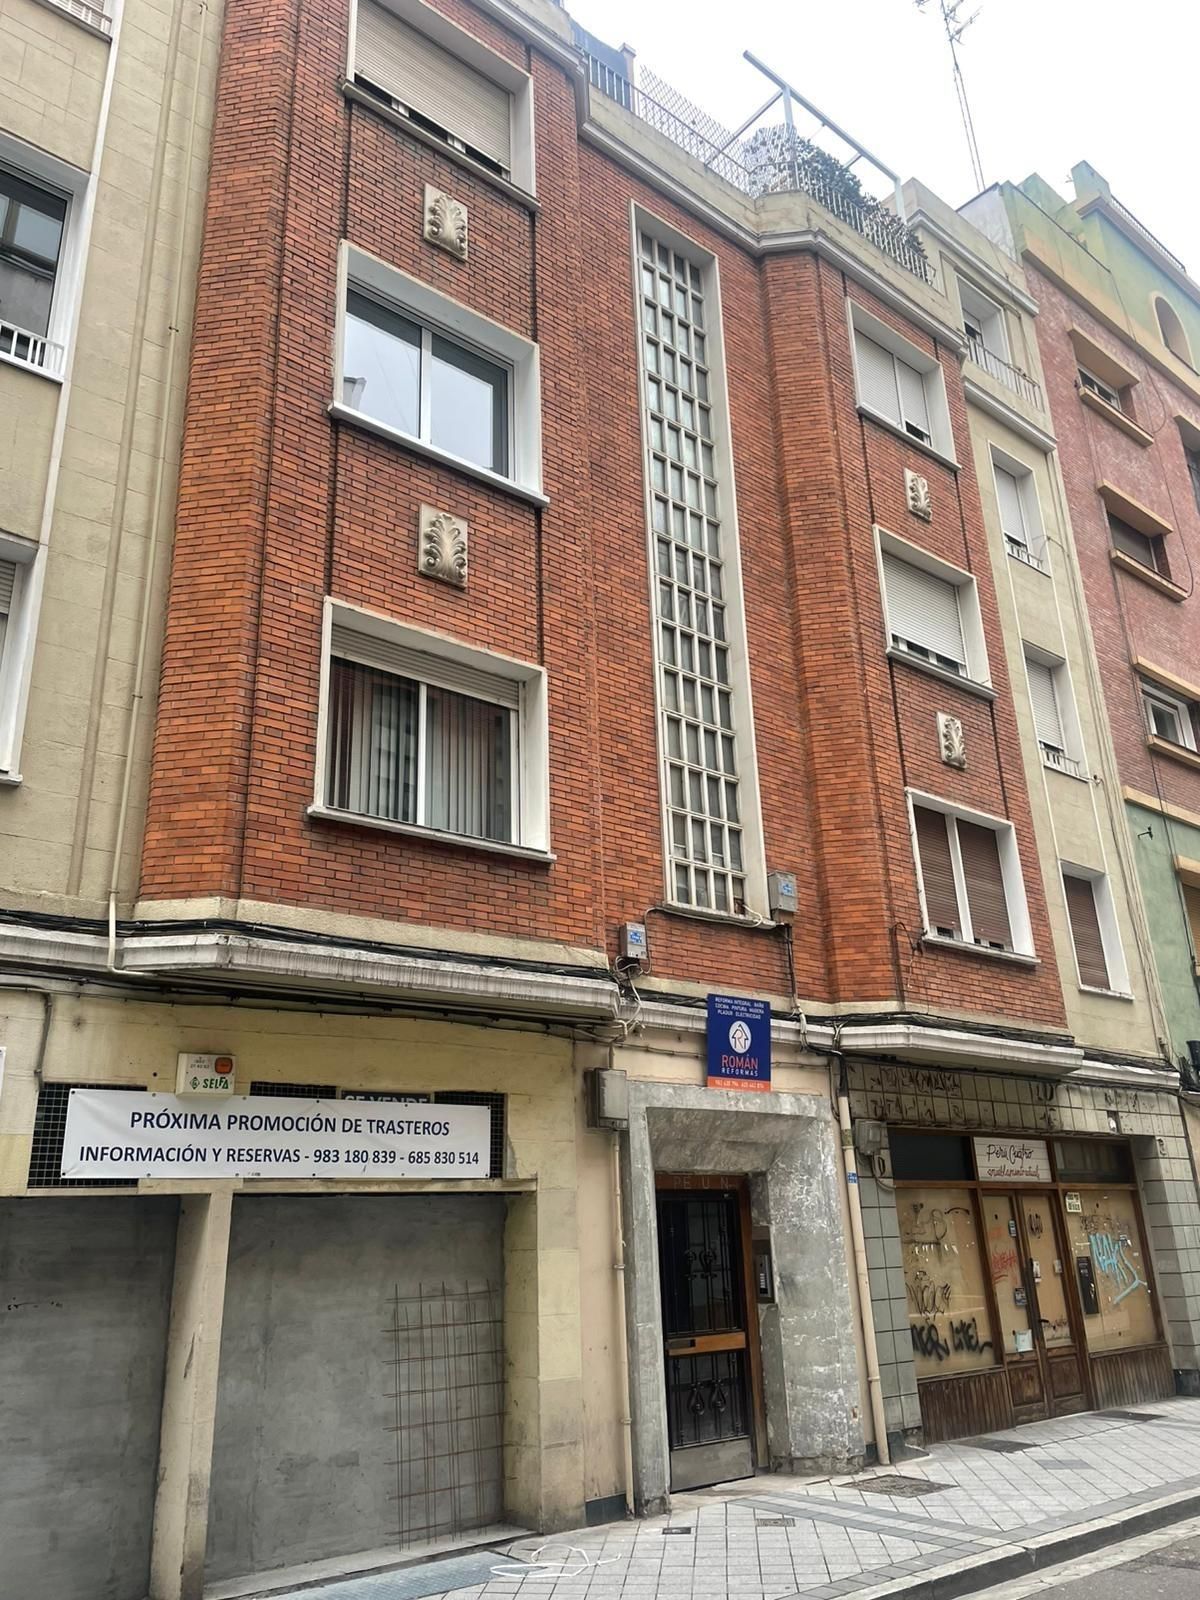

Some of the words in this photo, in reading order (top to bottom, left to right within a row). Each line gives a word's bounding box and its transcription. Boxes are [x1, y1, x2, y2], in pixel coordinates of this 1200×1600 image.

[721, 1054, 759, 1070] ROMÁN
[721, 1067, 759, 1077] REFORMAS
[203, 1076, 229, 1089] SELFA
[130, 1108, 221, 1130] PRÓXIMA
[227, 1113, 336, 1132] PROMOCIÓN
[341, 1118, 363, 1133] DE
[366, 1119, 450, 1136] TRASTEROS
[79, 1144, 207, 1162] INFORMACIÓN
[212, 1148, 222, 1162] Y
[227, 1148, 300, 1163] RESERVAS
[313, 1149, 340, 1163] 983
[344, 1149, 369, 1164] 180
[372, 1150, 396, 1164] 839
[408, 1151, 431, 1164] 685
[434, 1151, 456, 1165] 830
[458, 1151, 479, 1165] 514
